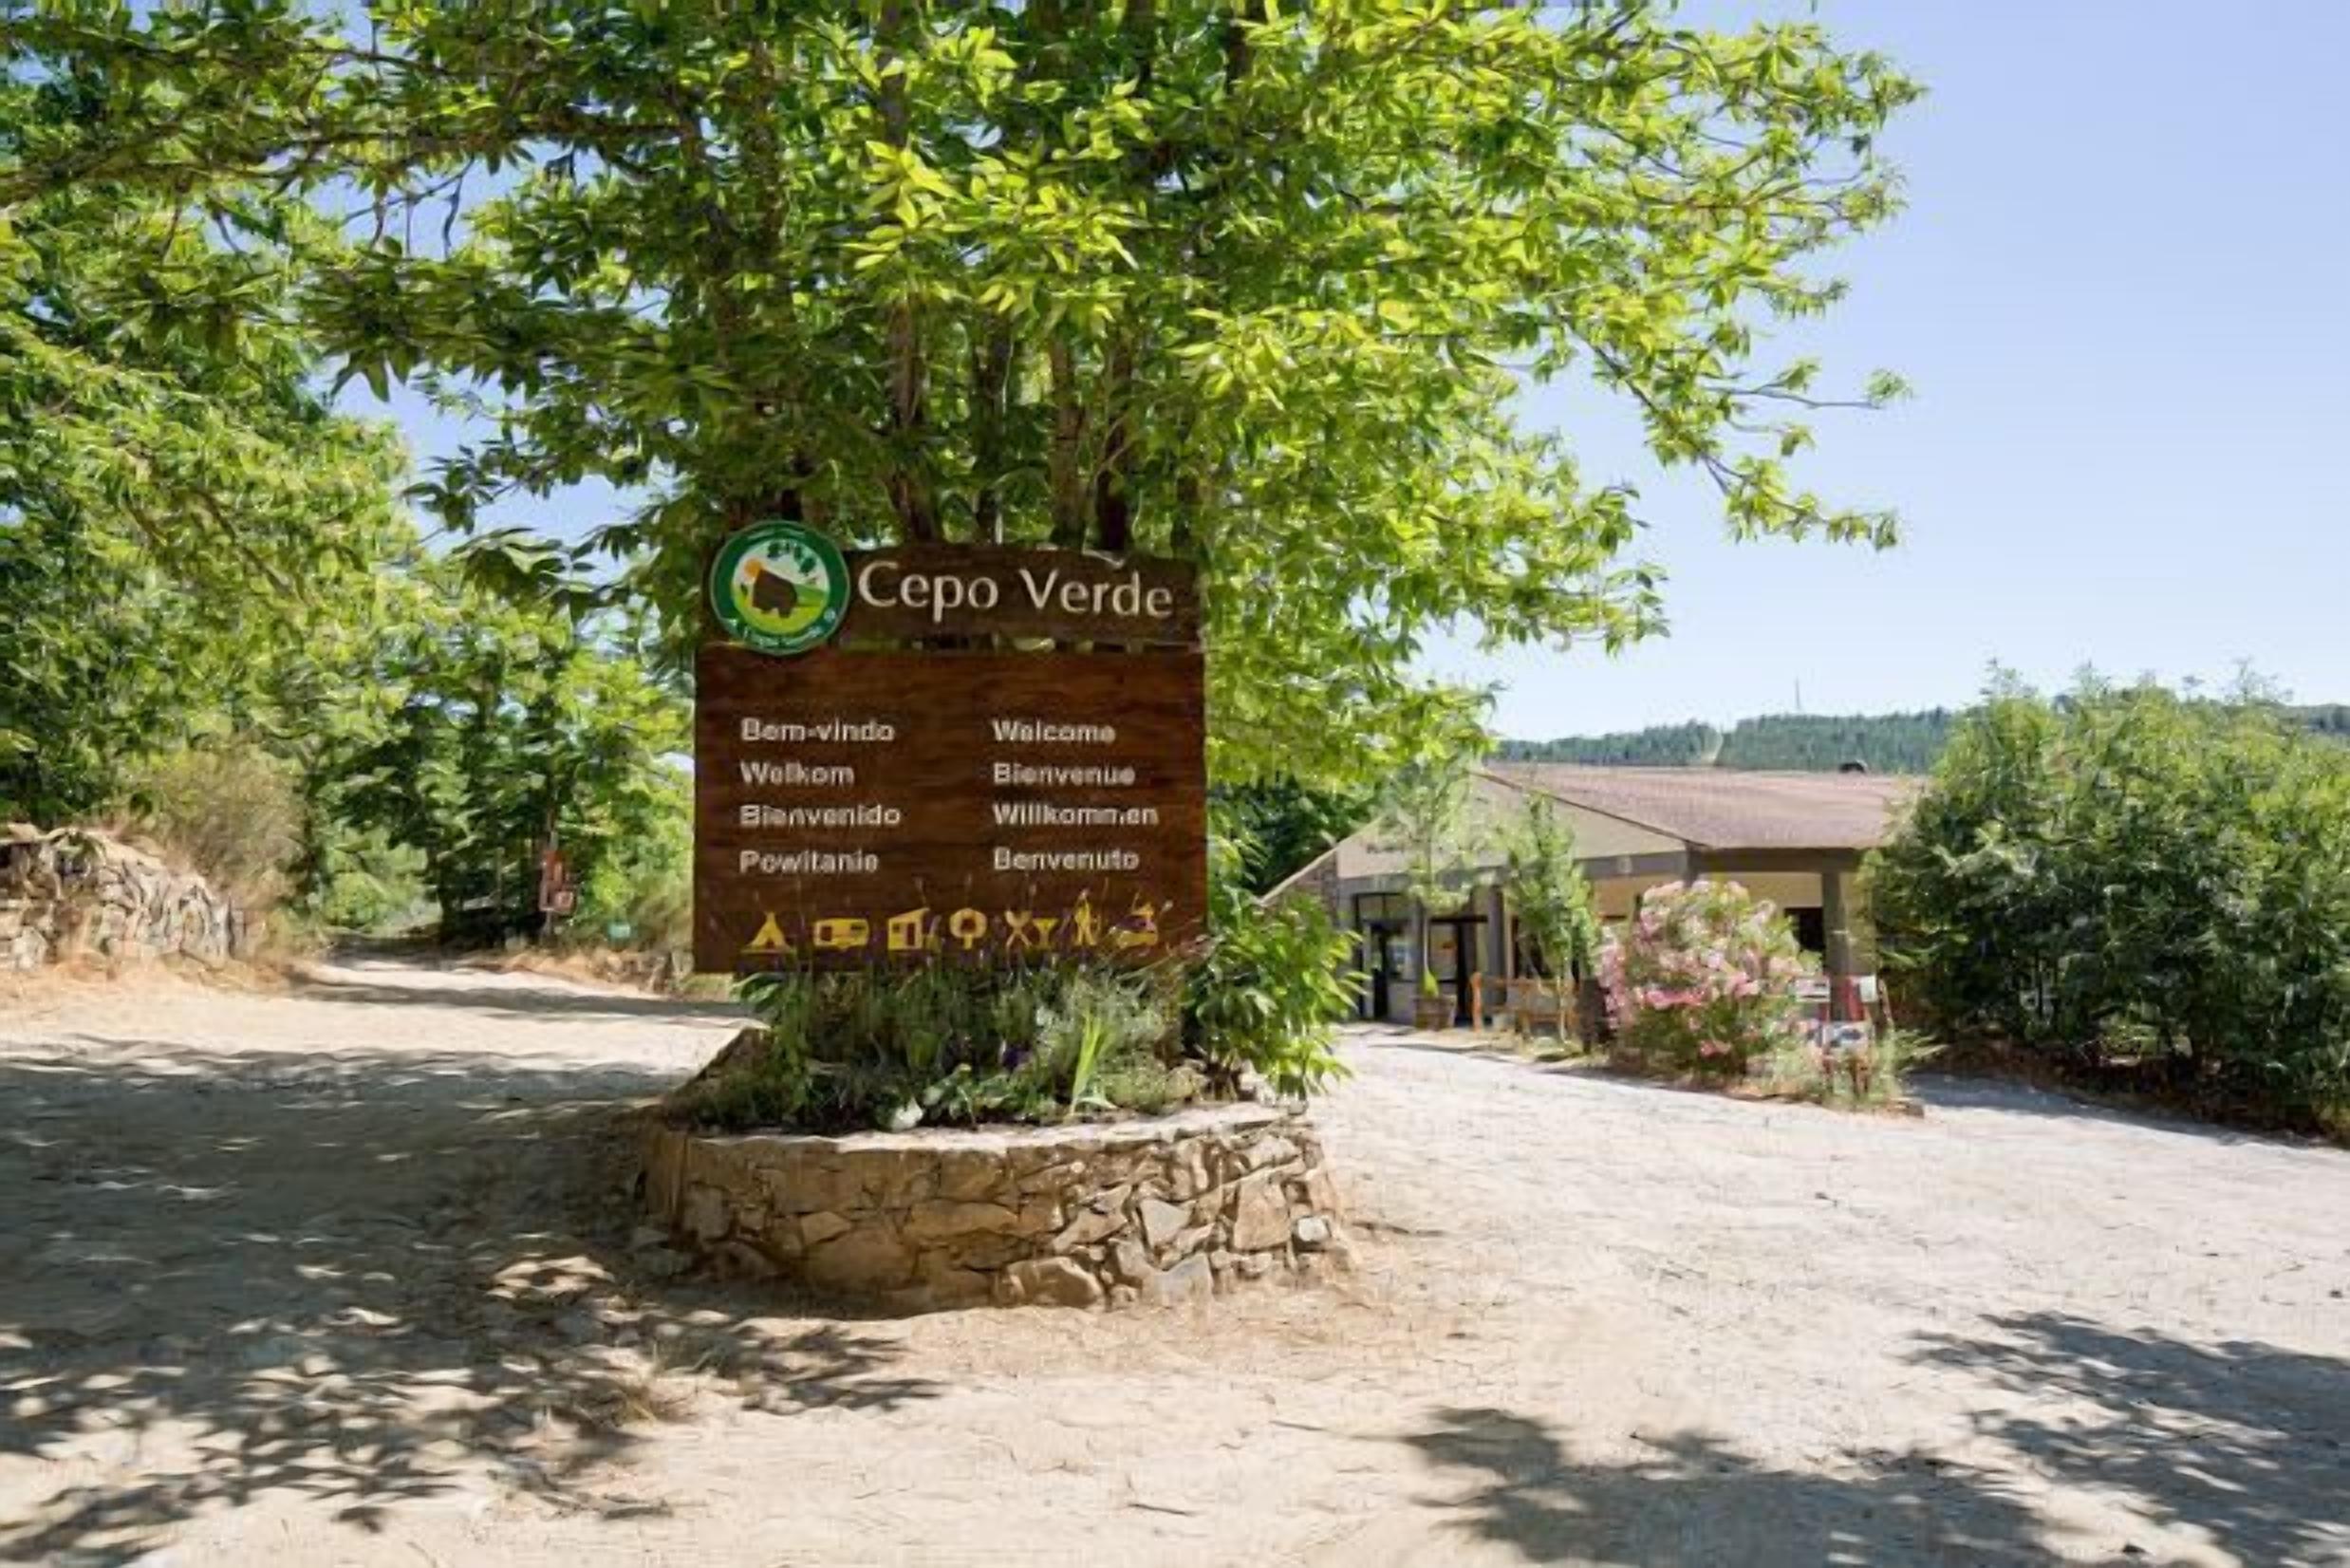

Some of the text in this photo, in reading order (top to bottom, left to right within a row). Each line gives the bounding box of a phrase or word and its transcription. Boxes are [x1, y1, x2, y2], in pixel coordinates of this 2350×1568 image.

[857, 560, 1174, 623] Cepo Verde
[992, 719, 1116, 742] Welcome
[740, 759, 854, 784] Welkom
[994, 761, 1135, 785] Bienvenue
[739, 804, 901, 828] Bienvenido
[992, 802, 1159, 825] Willkommen
[994, 846, 1139, 870] Benvenuto
